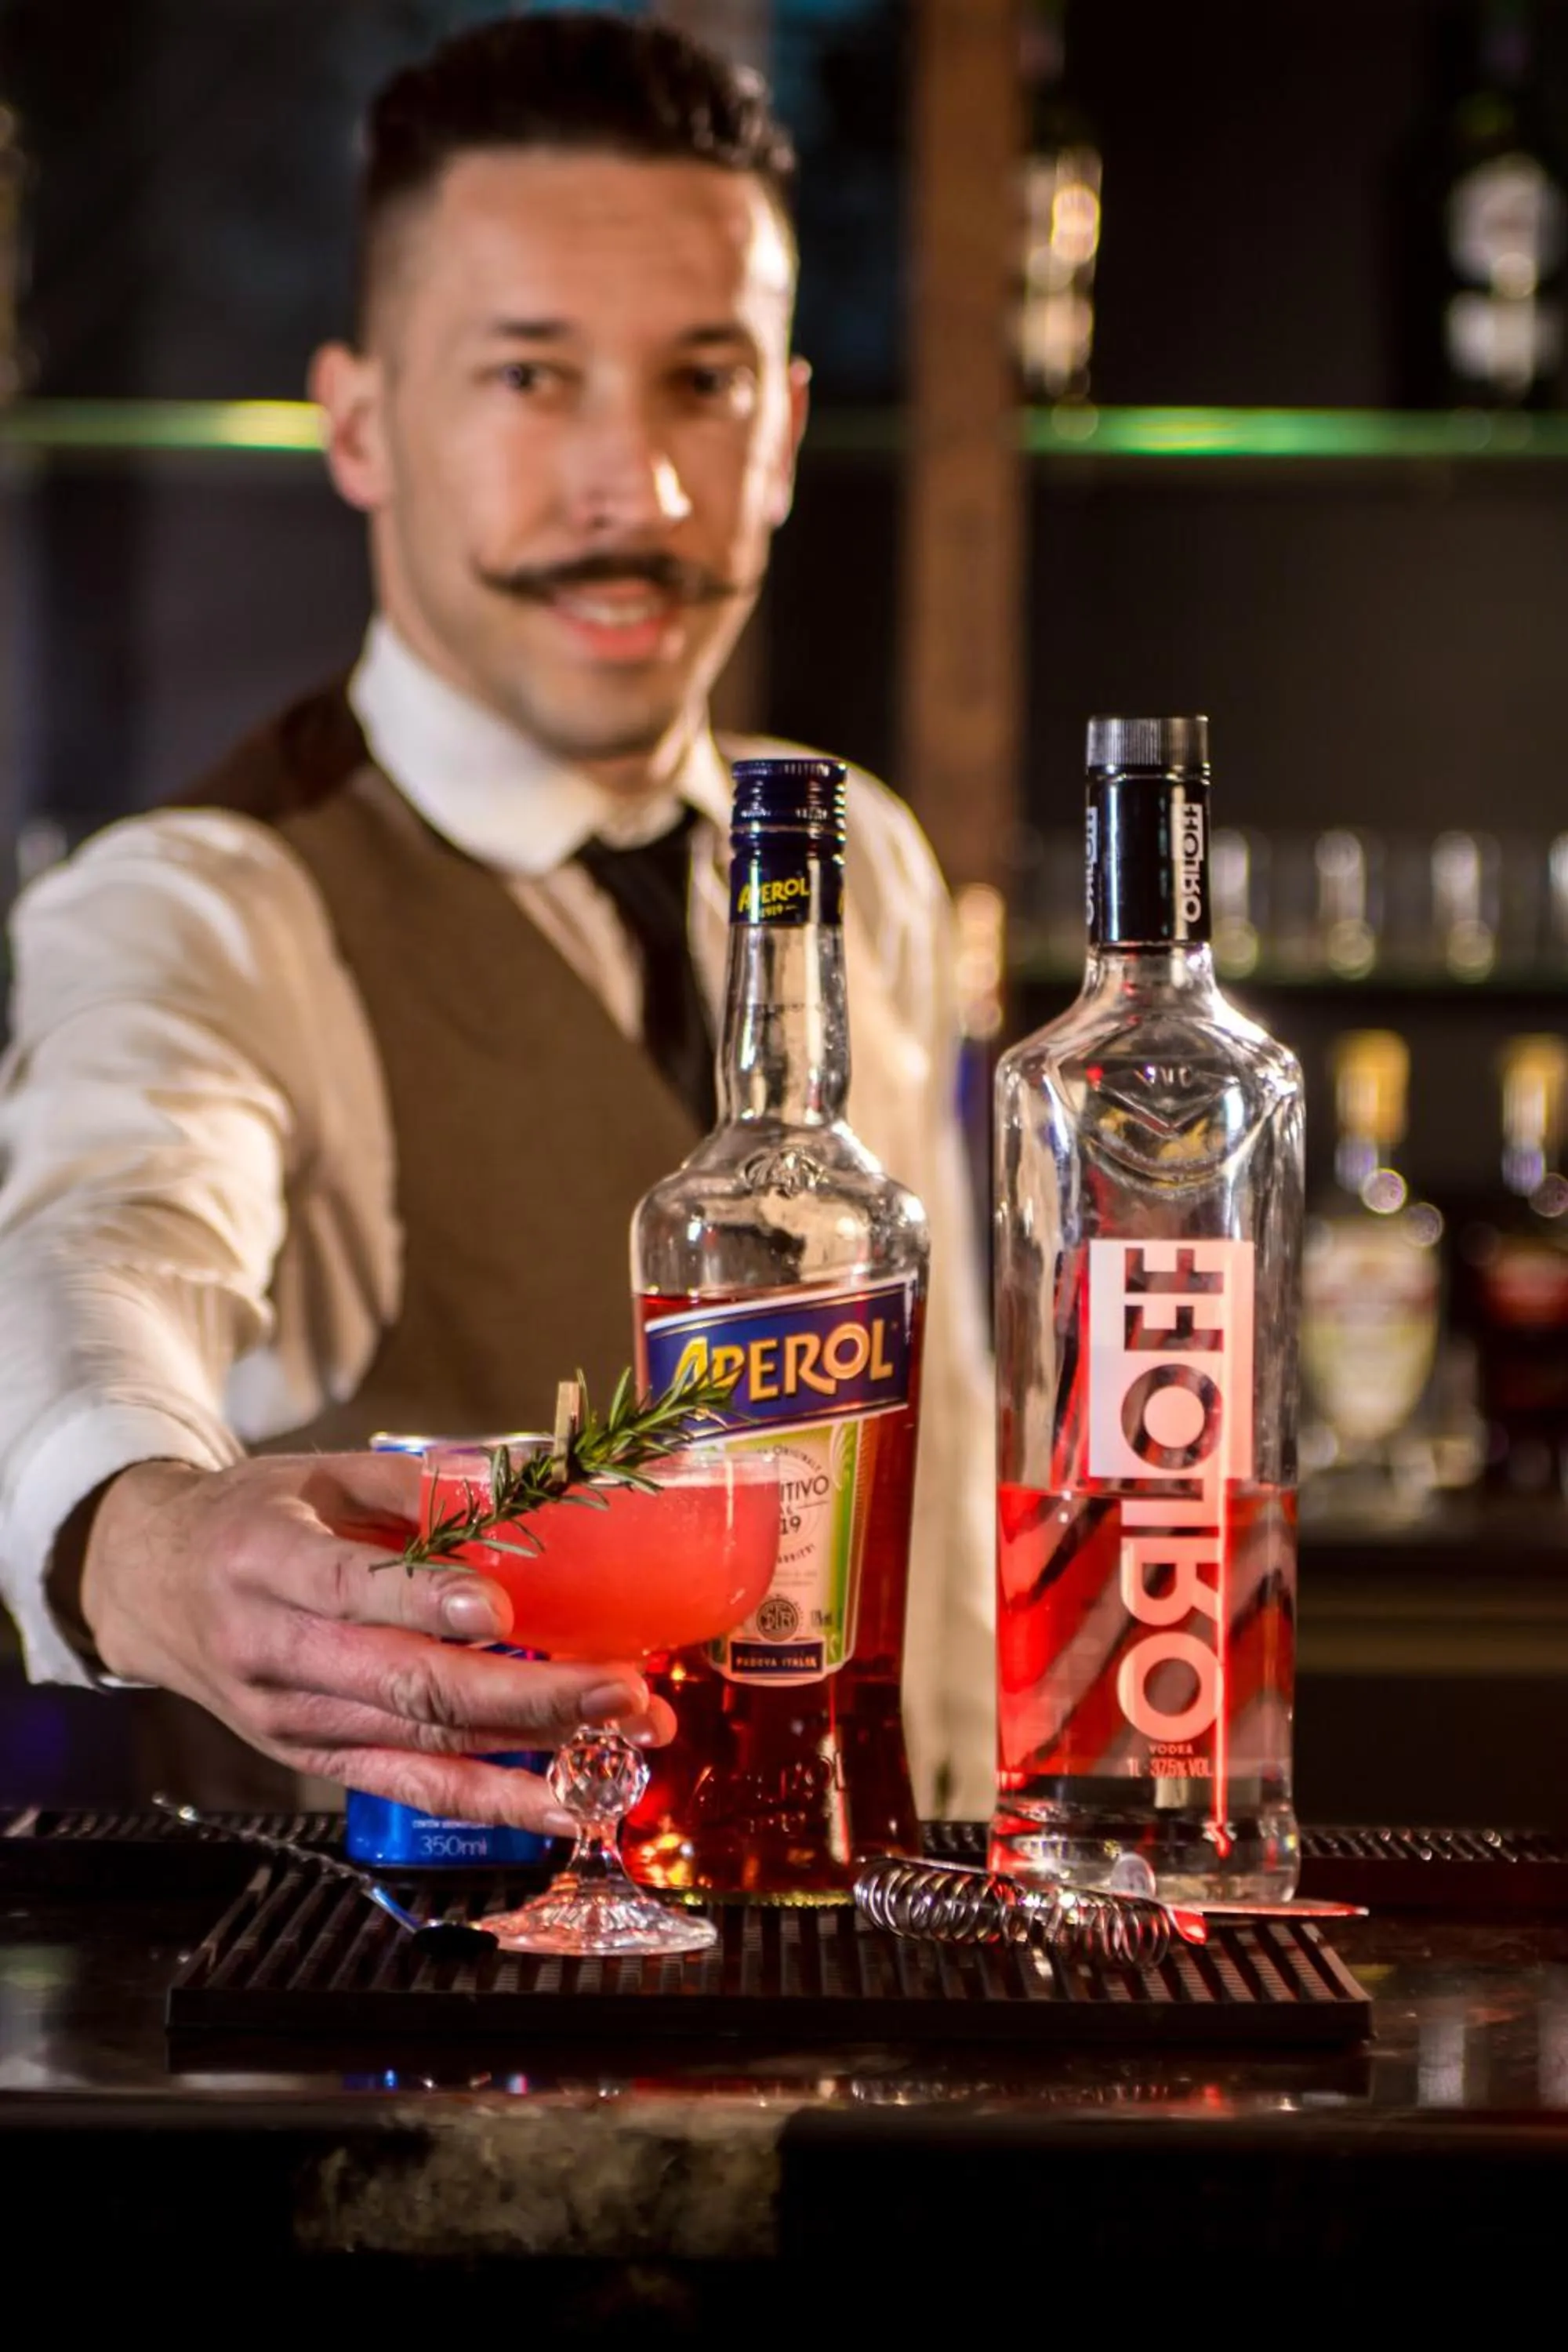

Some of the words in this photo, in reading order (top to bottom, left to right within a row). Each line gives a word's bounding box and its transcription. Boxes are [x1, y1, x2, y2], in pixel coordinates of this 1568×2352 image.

[738, 877, 810, 913] AEROL
[673, 1319, 894, 1402] APEROL
[780, 1475, 829, 1503] ITIVO
[1149, 1744, 1193, 1755] VODKA
[419, 1835, 487, 1857] 350ml
